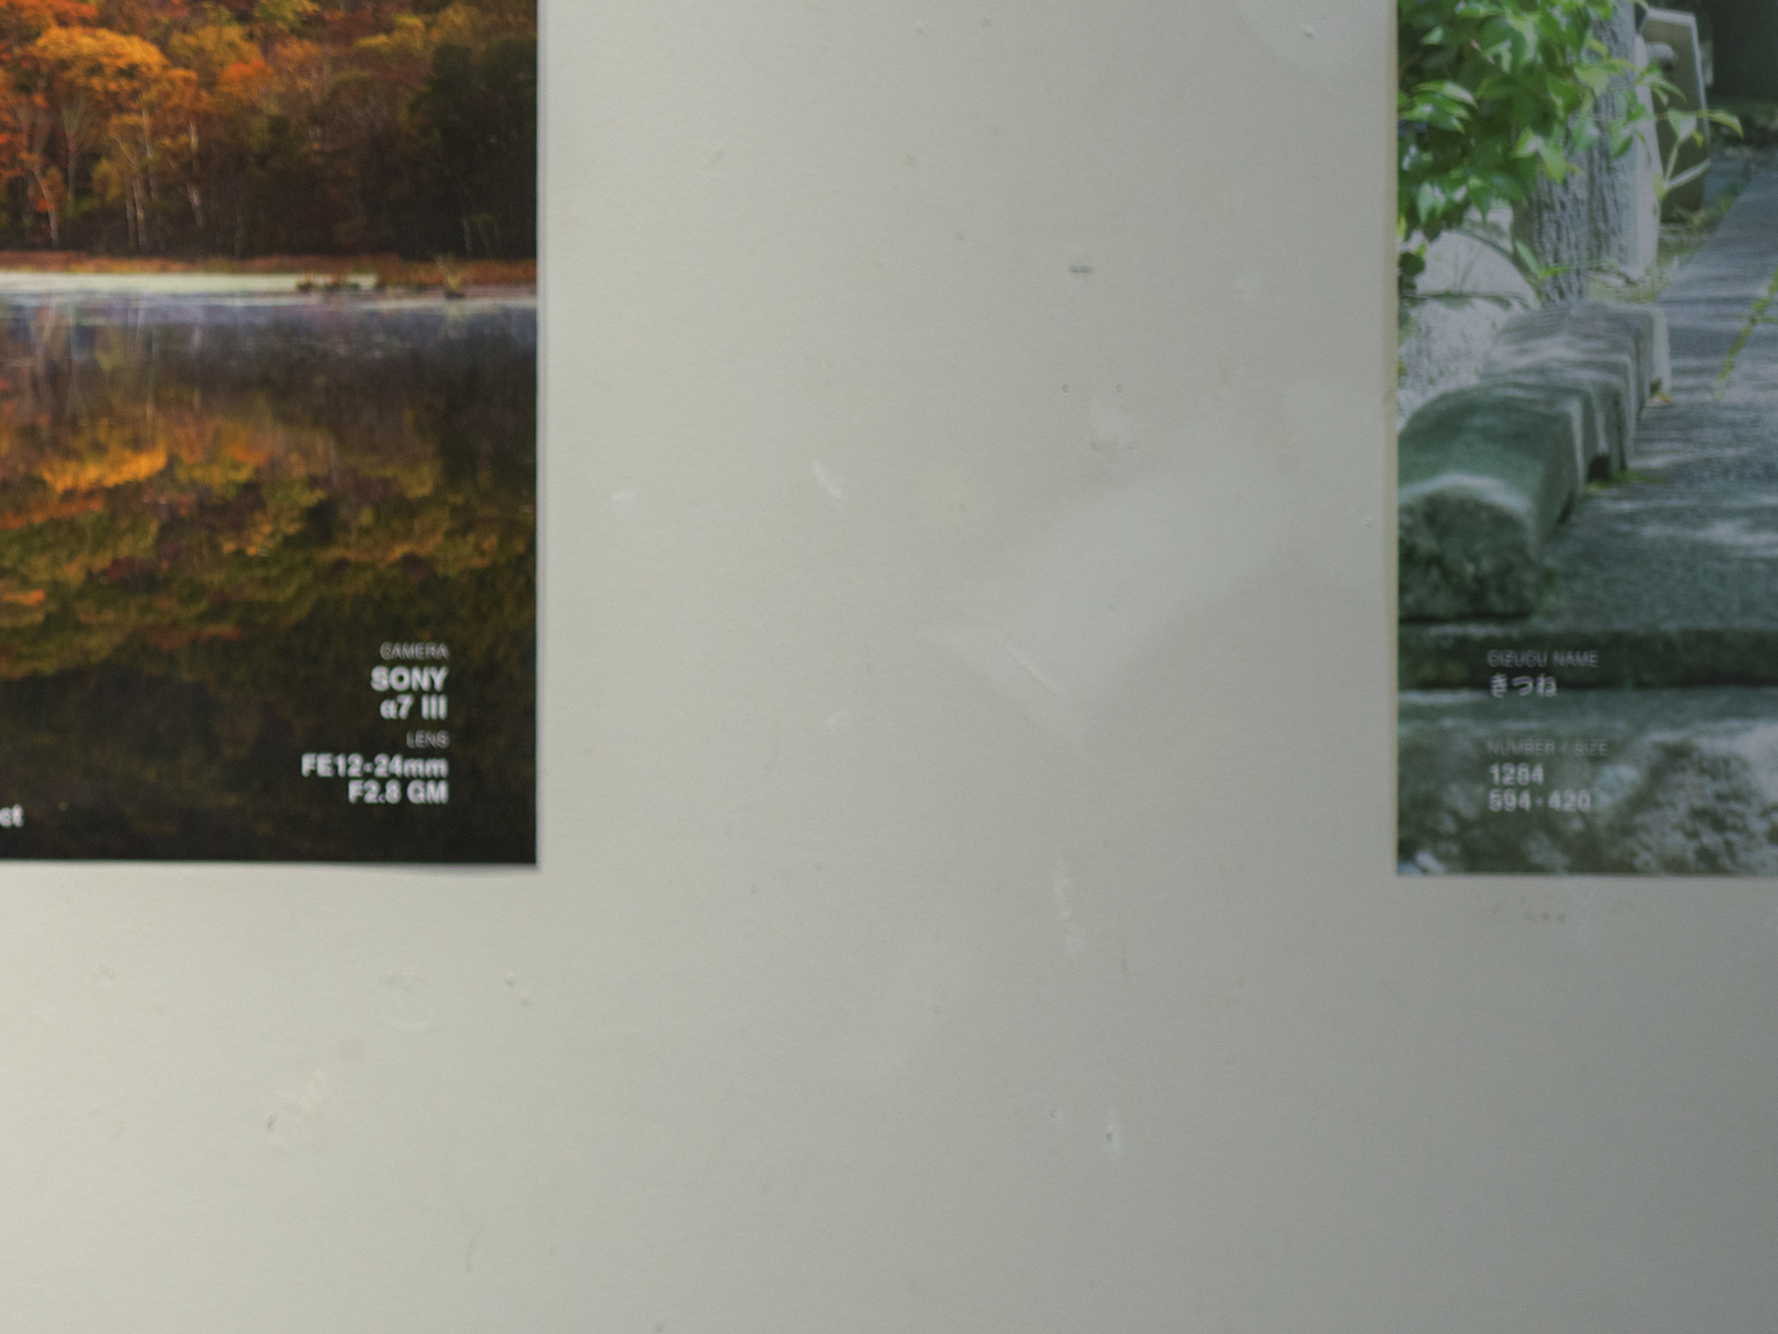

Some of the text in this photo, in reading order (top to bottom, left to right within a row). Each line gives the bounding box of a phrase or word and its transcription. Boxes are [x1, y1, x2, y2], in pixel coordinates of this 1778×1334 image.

[380, 642, 450, 660] CAMERA
[1552, 650, 1599, 668] NAME
[370, 665, 450, 692] SONY
[406, 730, 450, 749] LENS
[1487, 738, 1556, 756] NUMBER
[301, 752, 450, 778] FE12-24mm
[348, 779, 450, 804] F2.8 GM
